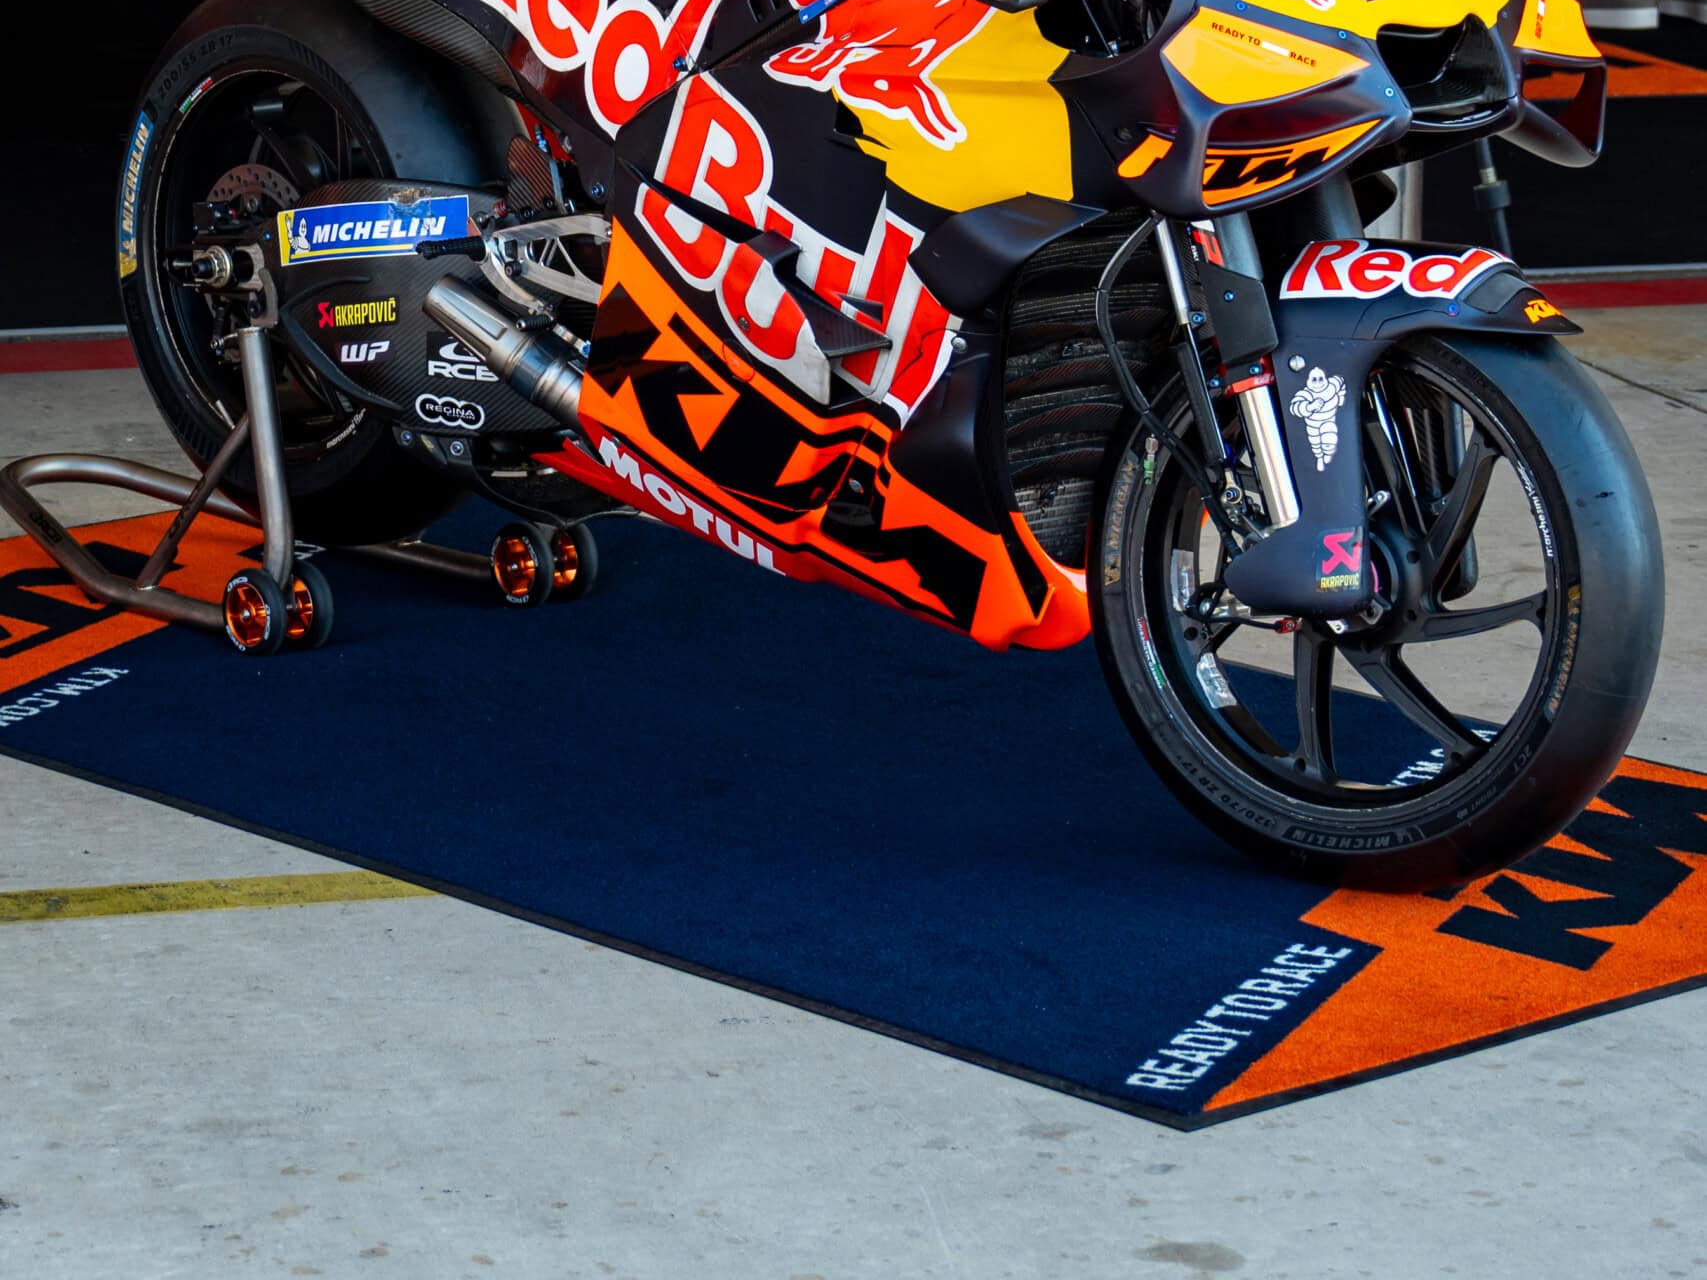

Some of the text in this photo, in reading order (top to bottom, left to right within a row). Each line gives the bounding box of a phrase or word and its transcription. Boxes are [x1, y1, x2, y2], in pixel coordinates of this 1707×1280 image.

[1211, 22, 1317, 67] READY TO RACE
[122, 122, 150, 234] MICHELIN
[312, 216, 446, 245] MICHELIN
[634, 71, 963, 430] Bull
[1280, 239, 1516, 300] Red
[340, 340, 390, 363] WP
[428, 360, 500, 382] RCB
[425, 403, 475, 418] REGINA
[599, 436, 787, 577] MOTUL
[1291, 824, 1392, 851] MICHELIN
[1125, 943, 1353, 1091] READY TO RACE
